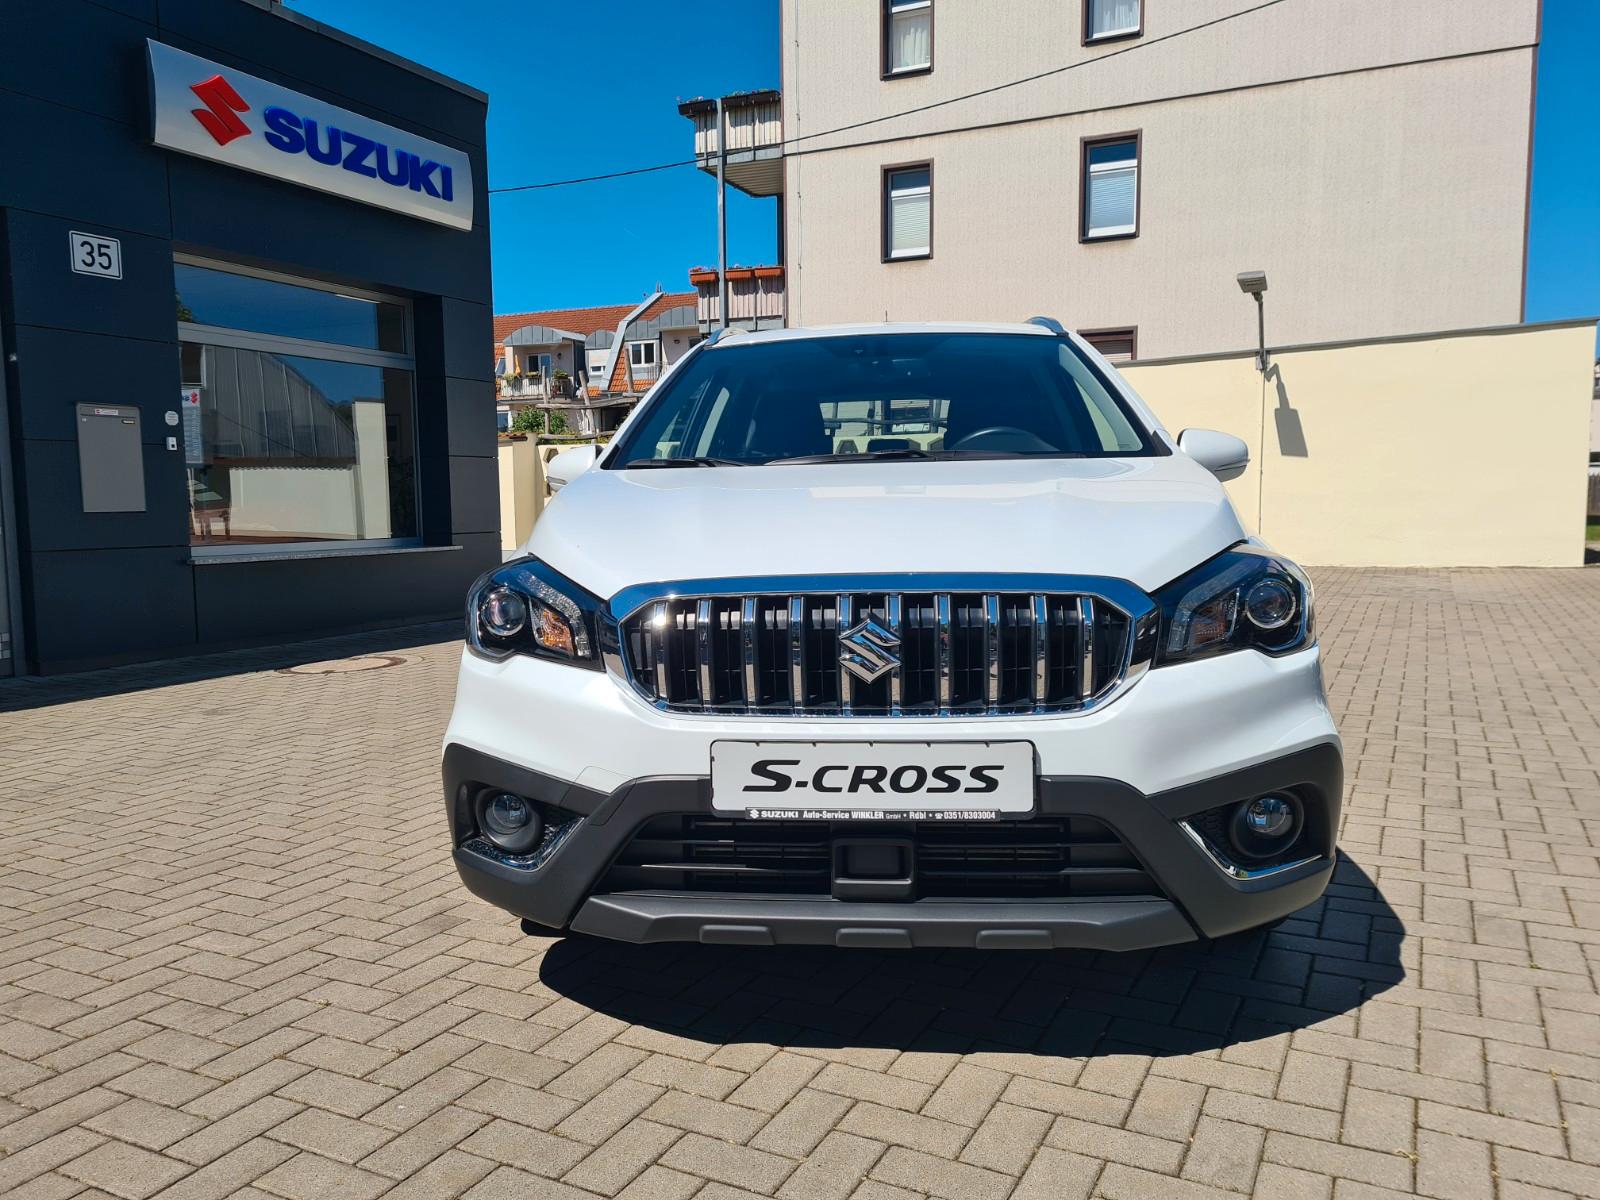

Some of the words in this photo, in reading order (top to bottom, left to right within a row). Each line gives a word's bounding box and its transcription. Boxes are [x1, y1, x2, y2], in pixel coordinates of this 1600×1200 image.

[263, 105, 454, 202] SUZUKI
[80, 240, 112, 271] 35
[742, 759, 1005, 794] S-CROSS
[761, 810, 799, 818] SUZUKI
[803, 810, 850, 819] Auto-Service
[851, 811, 884, 819] WINKLER
[943, 811, 996, 820] 0351/8303004
